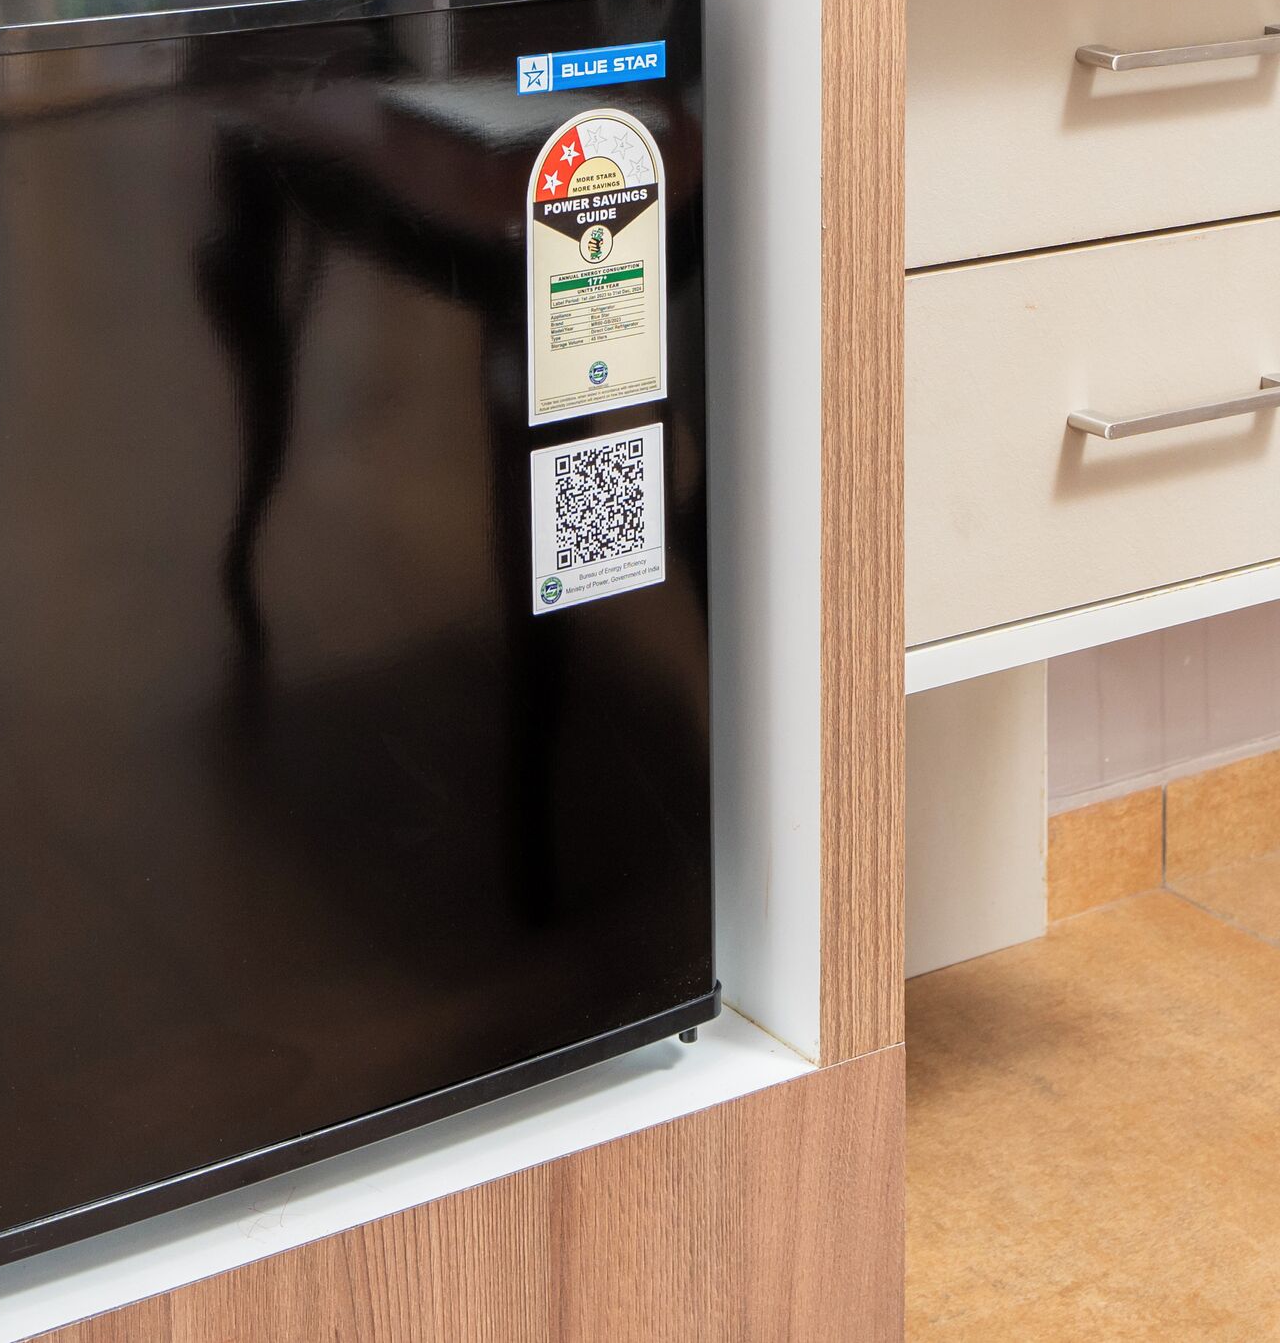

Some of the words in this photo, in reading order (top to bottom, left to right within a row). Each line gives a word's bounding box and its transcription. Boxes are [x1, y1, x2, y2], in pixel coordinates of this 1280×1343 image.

[561, 59, 608, 79] BLUE
[613, 53, 658, 72] STAR
[573, 184, 591, 193] MORE
[592, 181, 620, 190] SAVINGS
[576, 175, 594, 183] MORE
[596, 172, 616, 180] STARS
[544, 197, 590, 215] POWER
[593, 188, 648, 207] SAVINGS
[577, 208, 616, 224] GUIDE
[581, 269, 602, 277] ENERGY
[602, 263, 640, 273] CONSUMPTION
[578, 571, 598, 581] Bureau
[599, 568, 604, 576] of
[604, 564, 622, 574] Energy
[623, 559, 647, 569] Efficiency
[565, 584, 585, 595] Ministry
[611, 570, 641, 583] Government
[648, 565, 660, 573] India
